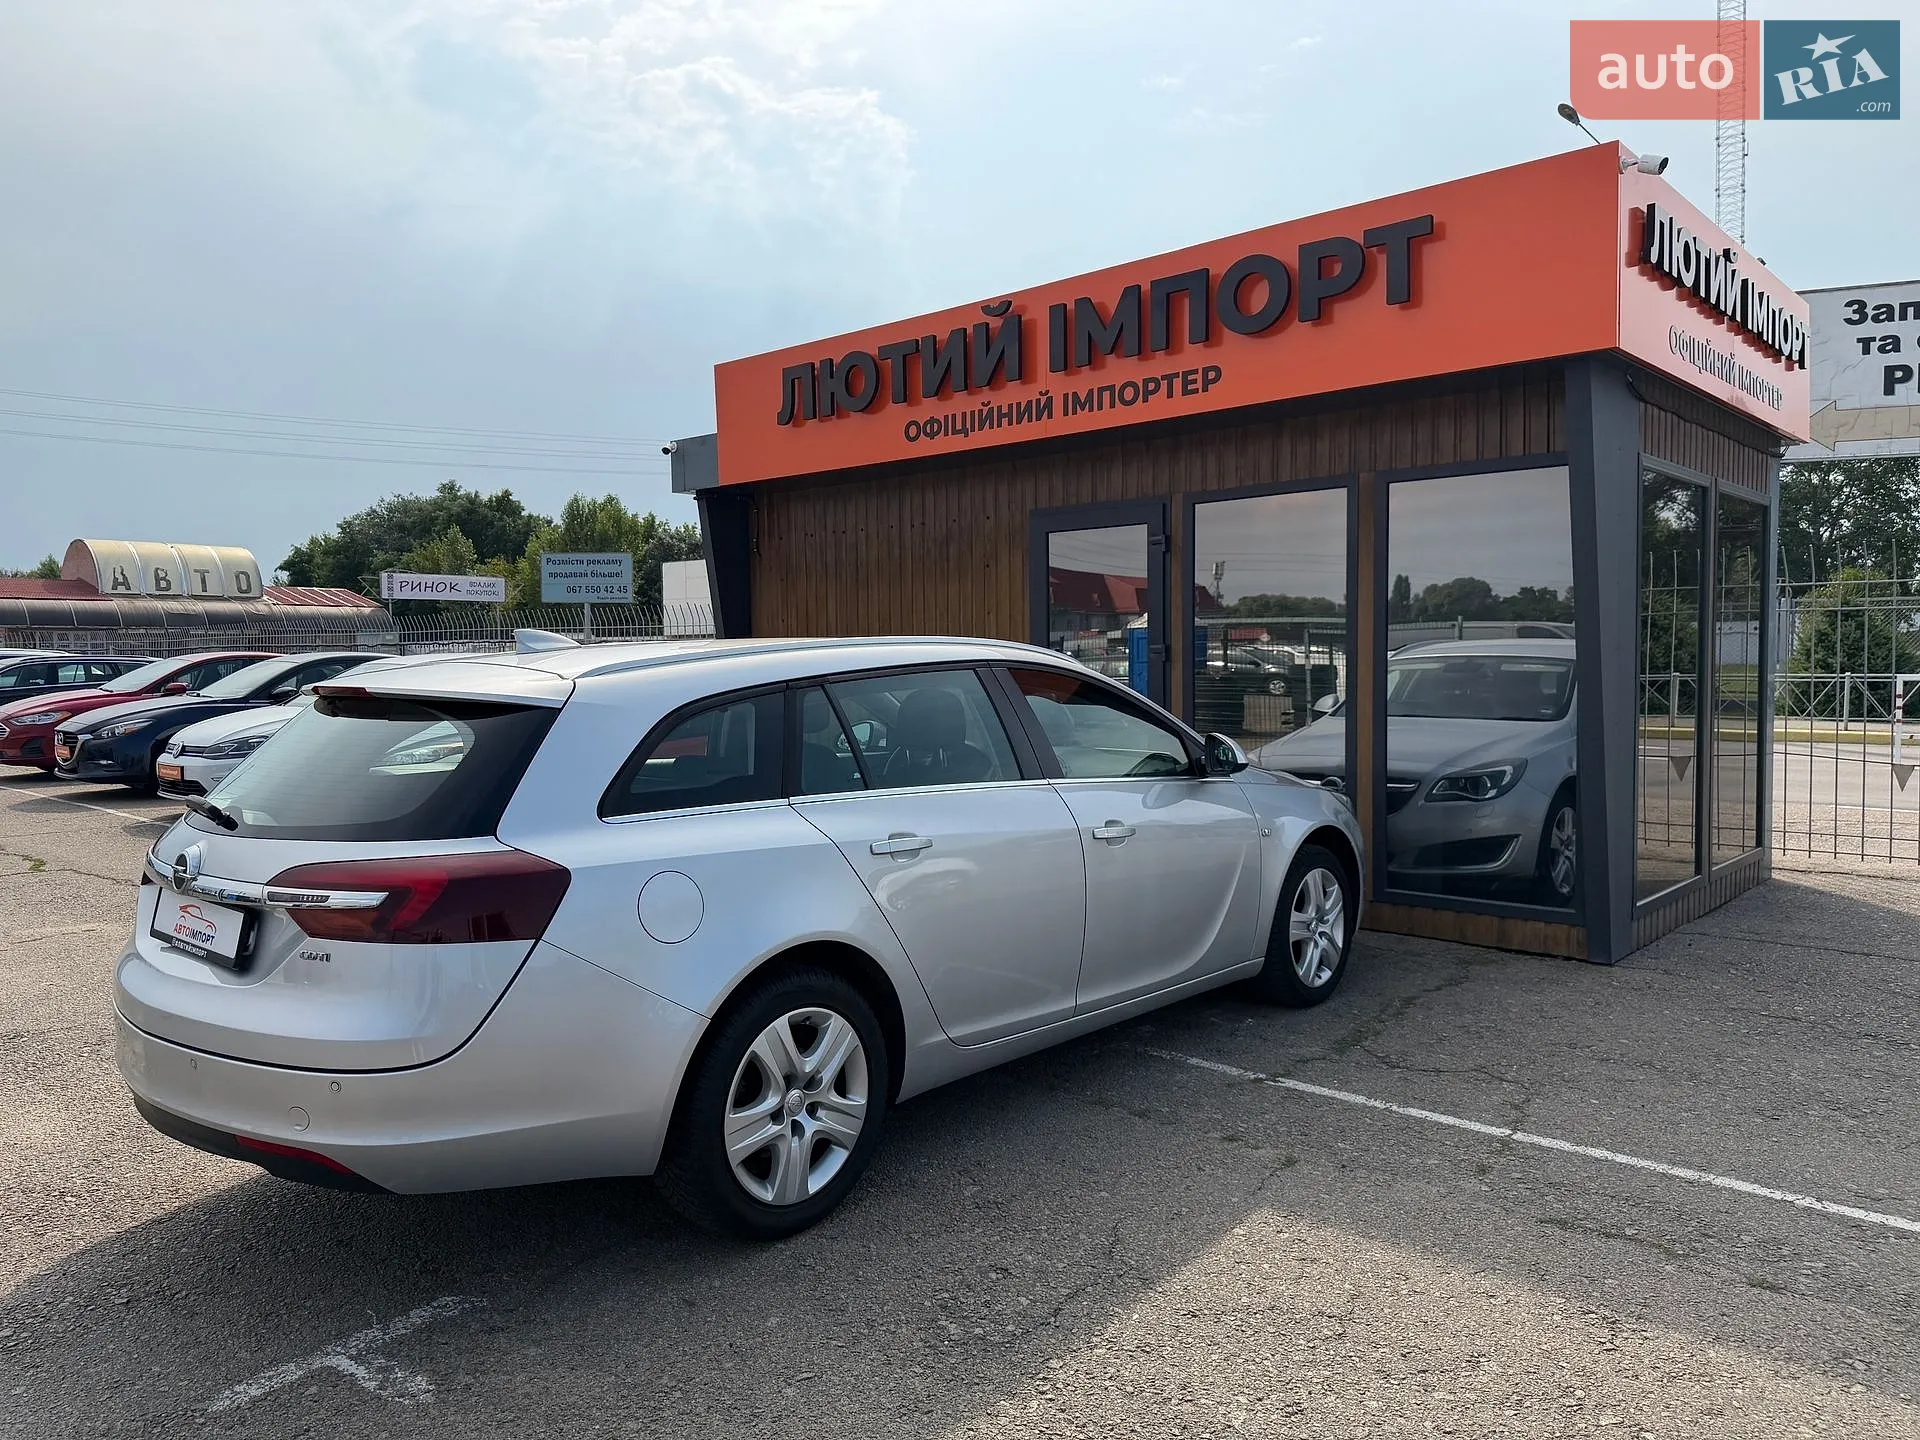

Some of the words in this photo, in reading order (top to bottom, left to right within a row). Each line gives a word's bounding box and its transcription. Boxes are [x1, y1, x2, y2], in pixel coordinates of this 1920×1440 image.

[1647, 203, 1742, 322] ЛЮТИЙ
[1743, 279, 1810, 369] ІМПОРТ
[777, 300, 1022, 425] ЛЮТИЙ
[1049, 214, 1433, 373] ІМПОРТ
[1856, 334, 1901, 355] та
[1669, 325, 1736, 387] ОФІЦІЙНИЙ
[1738, 363, 1782, 410] ІМПОРТЕР
[904, 389, 1053, 442] ОФІЦІЙНИЙ
[1062, 365, 1222, 416] ІМПОРТЕР
[546, 557, 584, 566] Розмісти
[586, 558, 623, 567] рекламу
[111, 565, 253, 594] АВТО
[548, 570, 588, 579] продавай
[590, 569, 623, 578] більше!
[399, 580, 462, 594] РИНОК
[566, 585, 582, 594] 067
[585, 585, 601, 594] 550
[603, 585, 615, 594] 42
[617, 585, 628, 594] 45
[173, 923, 215, 946] АВТОІМПОРТ
